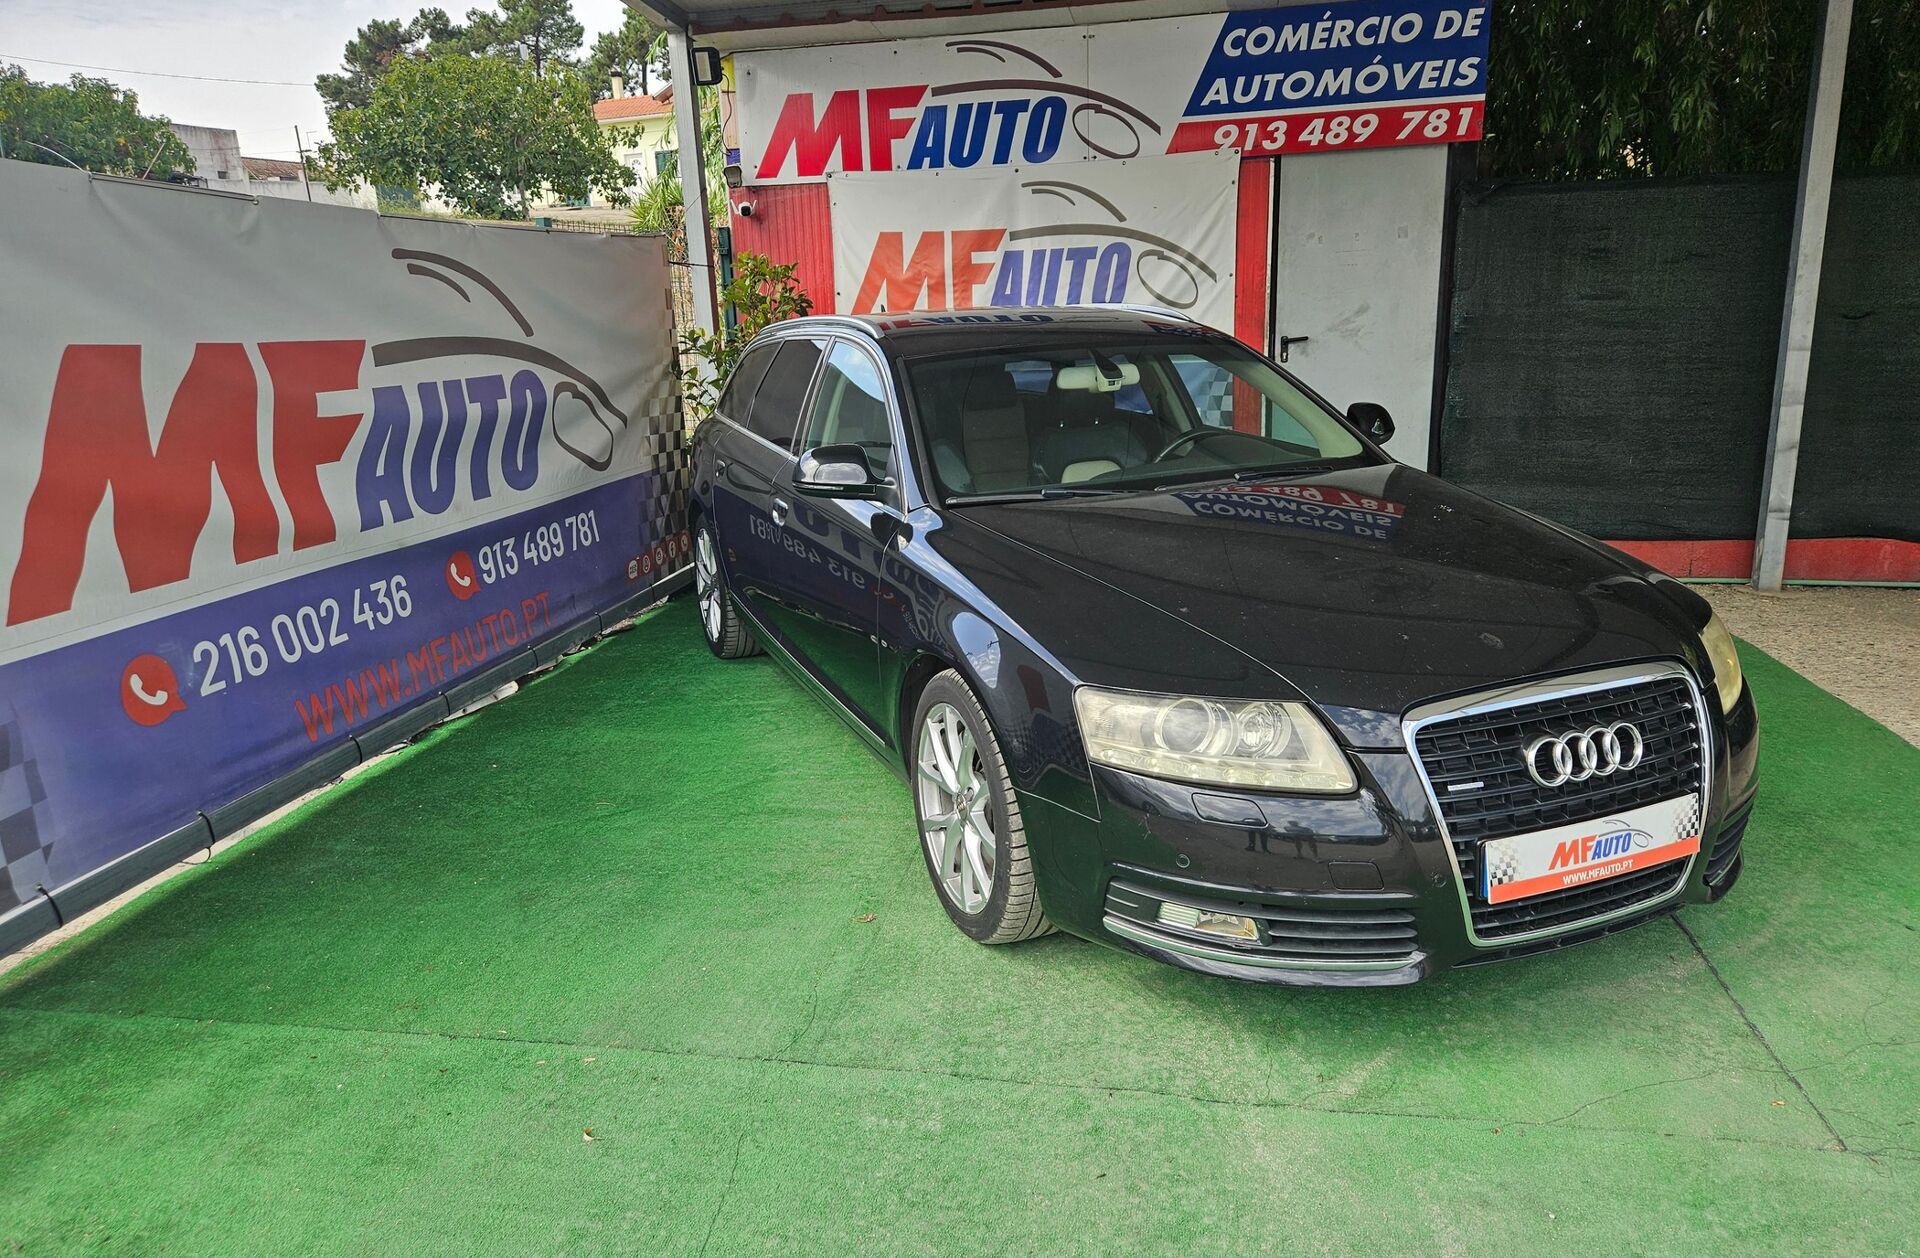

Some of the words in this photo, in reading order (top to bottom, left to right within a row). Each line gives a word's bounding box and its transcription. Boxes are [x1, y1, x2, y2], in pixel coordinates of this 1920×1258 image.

[1223, 10, 1423, 57] COMÉRCIO
[1433, 7, 1486, 40] DE
[1200, 55, 1481, 106] AUTOMÓVEIS
[1213, 120, 1288, 151] 913
[1298, 113, 1379, 146] 489
[1396, 107, 1474, 140] 781
[477, 537, 519, 584] 913
[524, 521, 564, 567] 489
[565, 510, 600, 547] 781
[192, 625, 269, 697] 216
[271, 598, 349, 663] 002
[353, 574, 412, 631] 436
[294, 592, 554, 743] WWW.MFAUTO.PT
[1563, 860, 1633, 885] WWW.MFAUTO.PT
